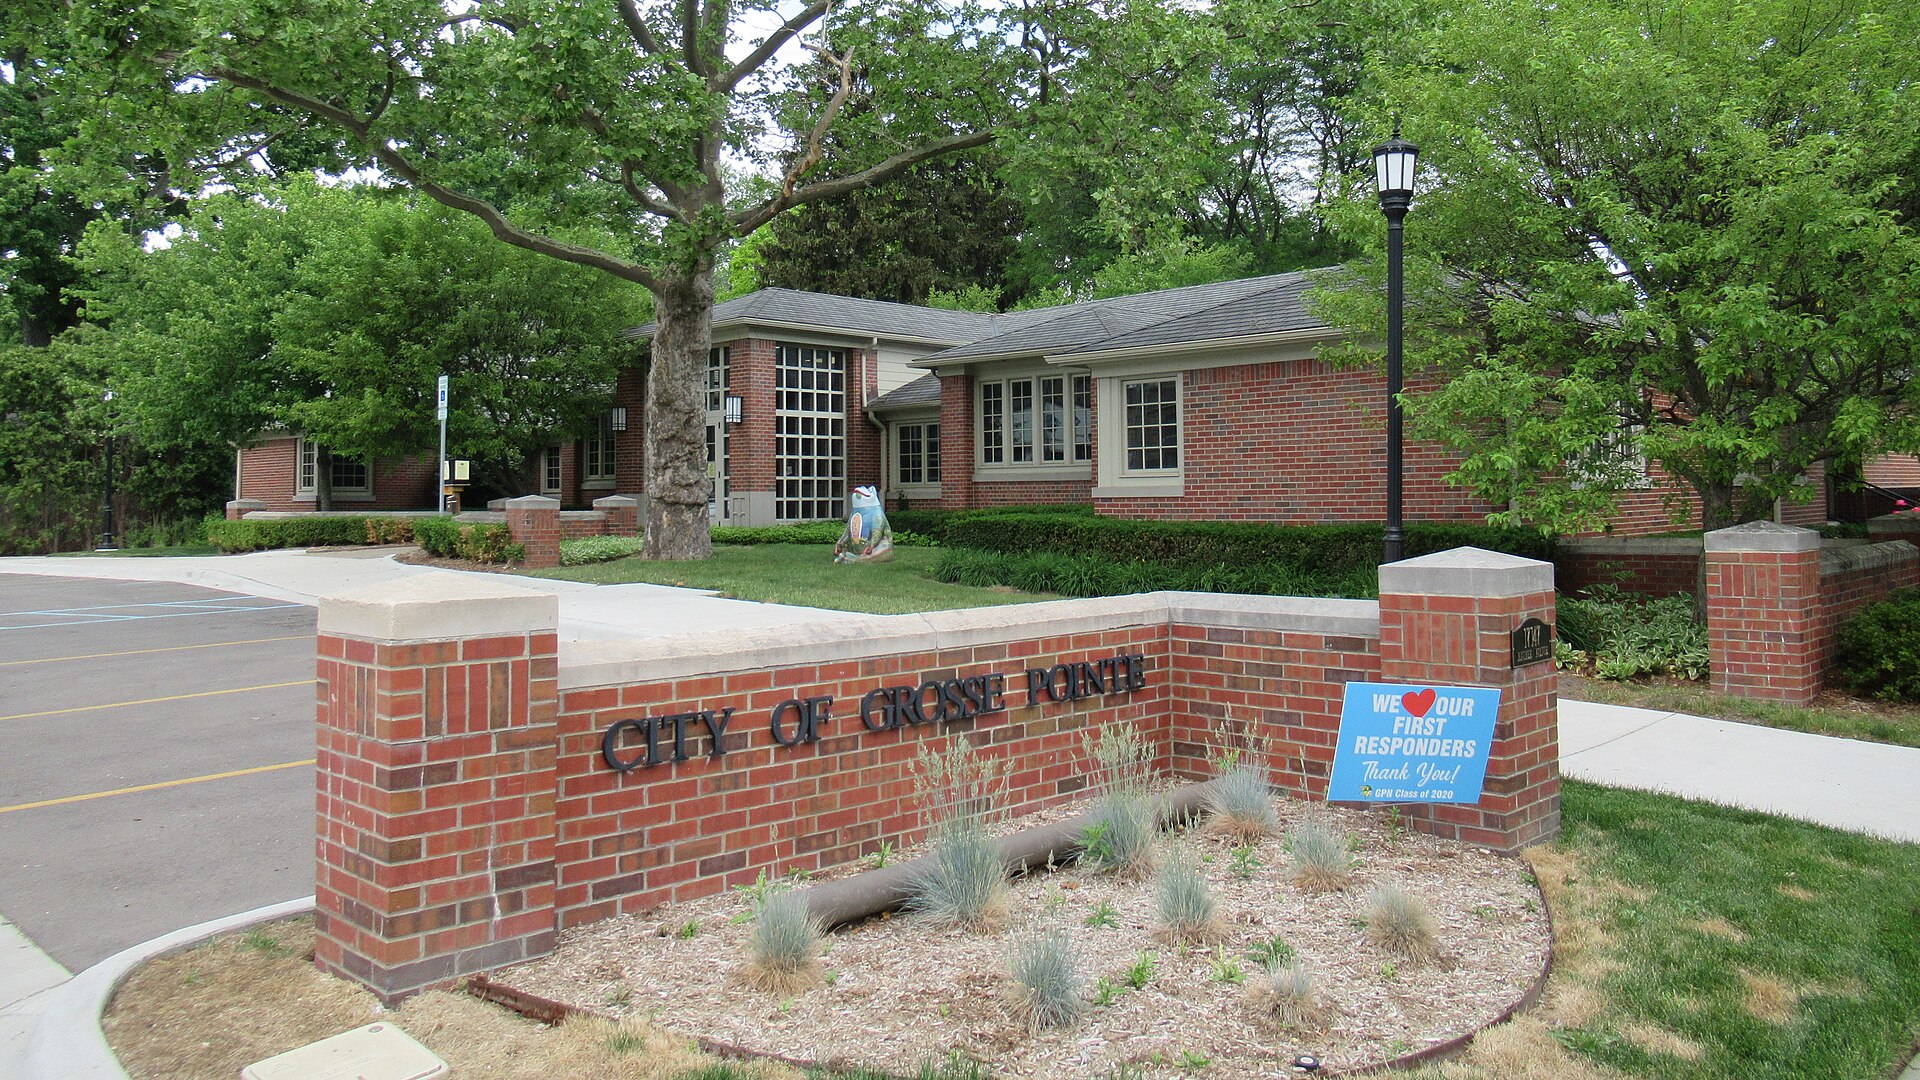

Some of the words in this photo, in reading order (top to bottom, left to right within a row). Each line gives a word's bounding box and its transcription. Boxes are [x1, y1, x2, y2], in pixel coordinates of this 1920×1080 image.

[602, 708, 736, 771] CITY
[771, 694, 833, 747] OF
[861, 673, 1006, 732] GROSSE
[1025, 654, 1147, 706] POINTE
[1373, 694, 1401, 714] WE
[1435, 696, 1475, 716] OUR
[1393, 716, 1447, 736] FIRST
[1354, 736, 1477, 758] RESPONDERS
[1362, 761, 1411, 782] Thank
[1416, 762, 1461, 787] You!
[1375, 788, 1393, 798] GPN
[1395, 789, 1418, 799] Class
[1419, 789, 1429, 799] of
[1431, 789, 1454, 799] 2020
